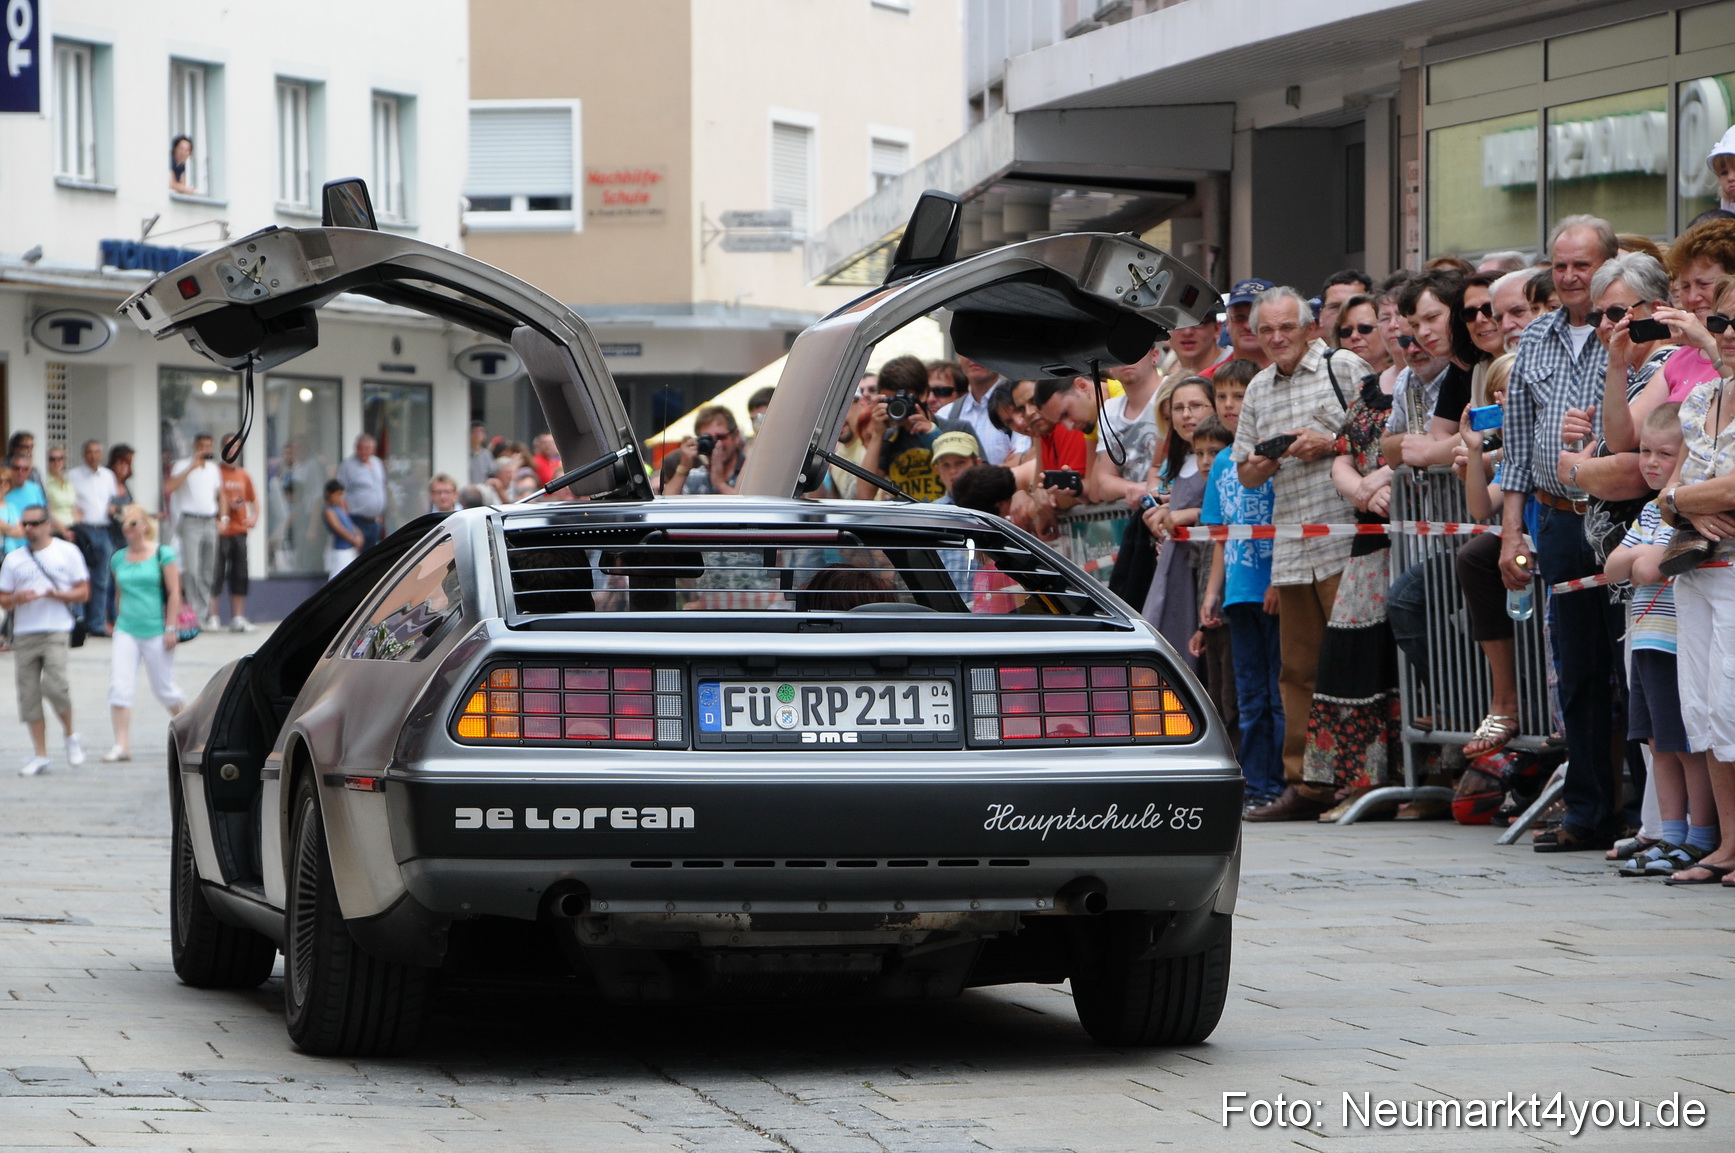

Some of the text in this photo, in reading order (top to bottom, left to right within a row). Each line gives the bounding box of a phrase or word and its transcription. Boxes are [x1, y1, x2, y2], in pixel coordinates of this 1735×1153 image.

[602, 188, 651, 206] Schule
[48, 319, 93, 345] T
[931, 685, 949, 697] 04
[801, 686, 848, 726] RP
[855, 685, 925, 725] 211
[705, 713, 714, 724] D
[934, 713, 950, 725] 10
[983, 803, 1203, 841] Hauptschule '85
